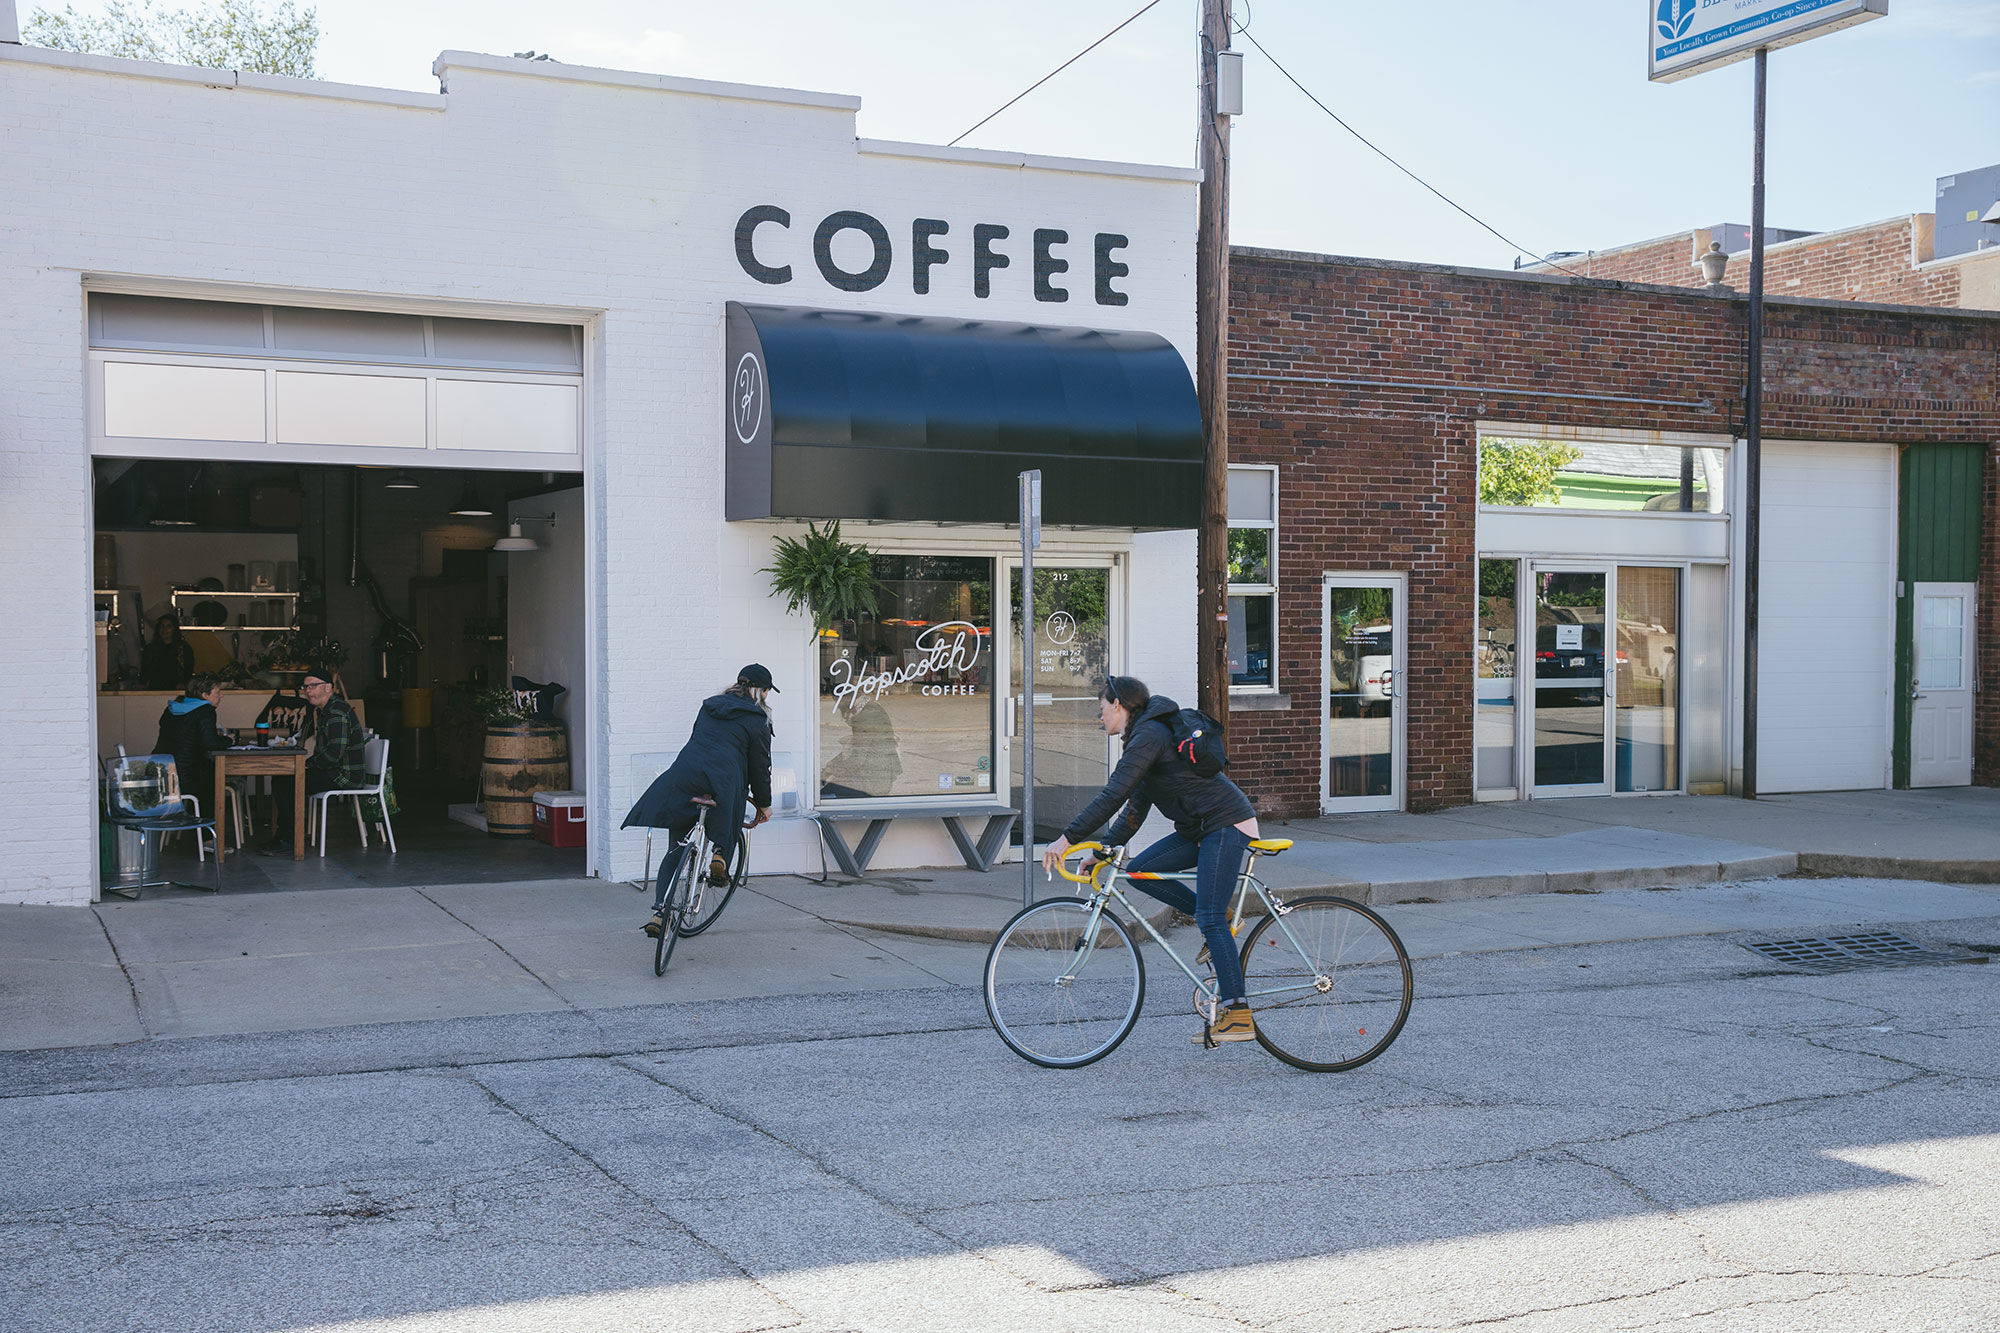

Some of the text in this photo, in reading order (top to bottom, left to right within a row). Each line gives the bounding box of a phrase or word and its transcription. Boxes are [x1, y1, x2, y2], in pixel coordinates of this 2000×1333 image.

[1663, 46, 1678, 56] Your
[1680, 36, 1704, 51] Locally
[1705, 30, 1728, 42] Grown
[1729, 16, 1769, 34] Community
[1771, 8, 1794, 20] Co-op
[1796, 1, 1817, 13] Since
[735, 205, 1129, 306] COFFEE
[1053, 573, 1068, 581] 212
[830, 621, 981, 714] Hopscotch
[921, 684, 975, 697] COFFEE
